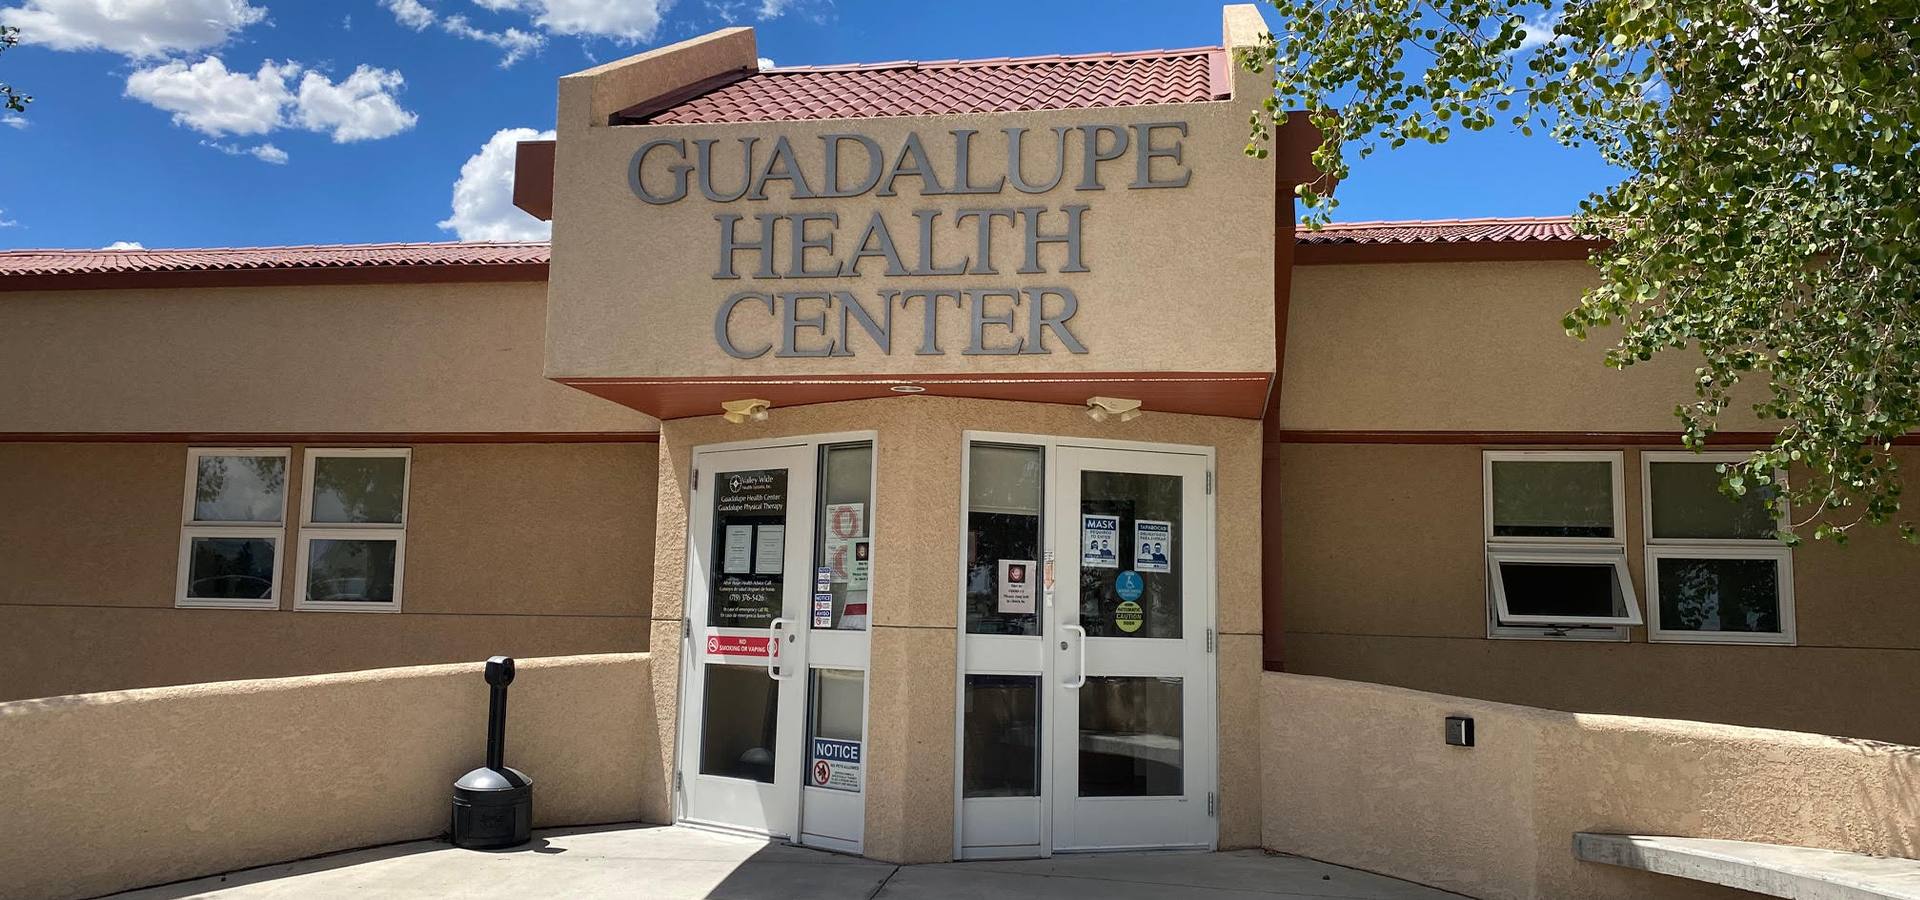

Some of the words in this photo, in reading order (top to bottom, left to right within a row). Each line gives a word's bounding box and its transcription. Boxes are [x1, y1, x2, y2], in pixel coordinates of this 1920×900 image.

[627, 121, 1192, 205] GUADALUPE
[712, 205, 1091, 279] HEALTH
[714, 287, 1088, 359] CENTER
[758, 475, 774, 483] Wide
[718, 504, 743, 512] Guadalupe
[744, 503, 763, 511] Physical
[764, 503, 783, 511] Therapy
[1087, 520, 1114, 529] MASK
[816, 743, 858, 760] NOTICE
